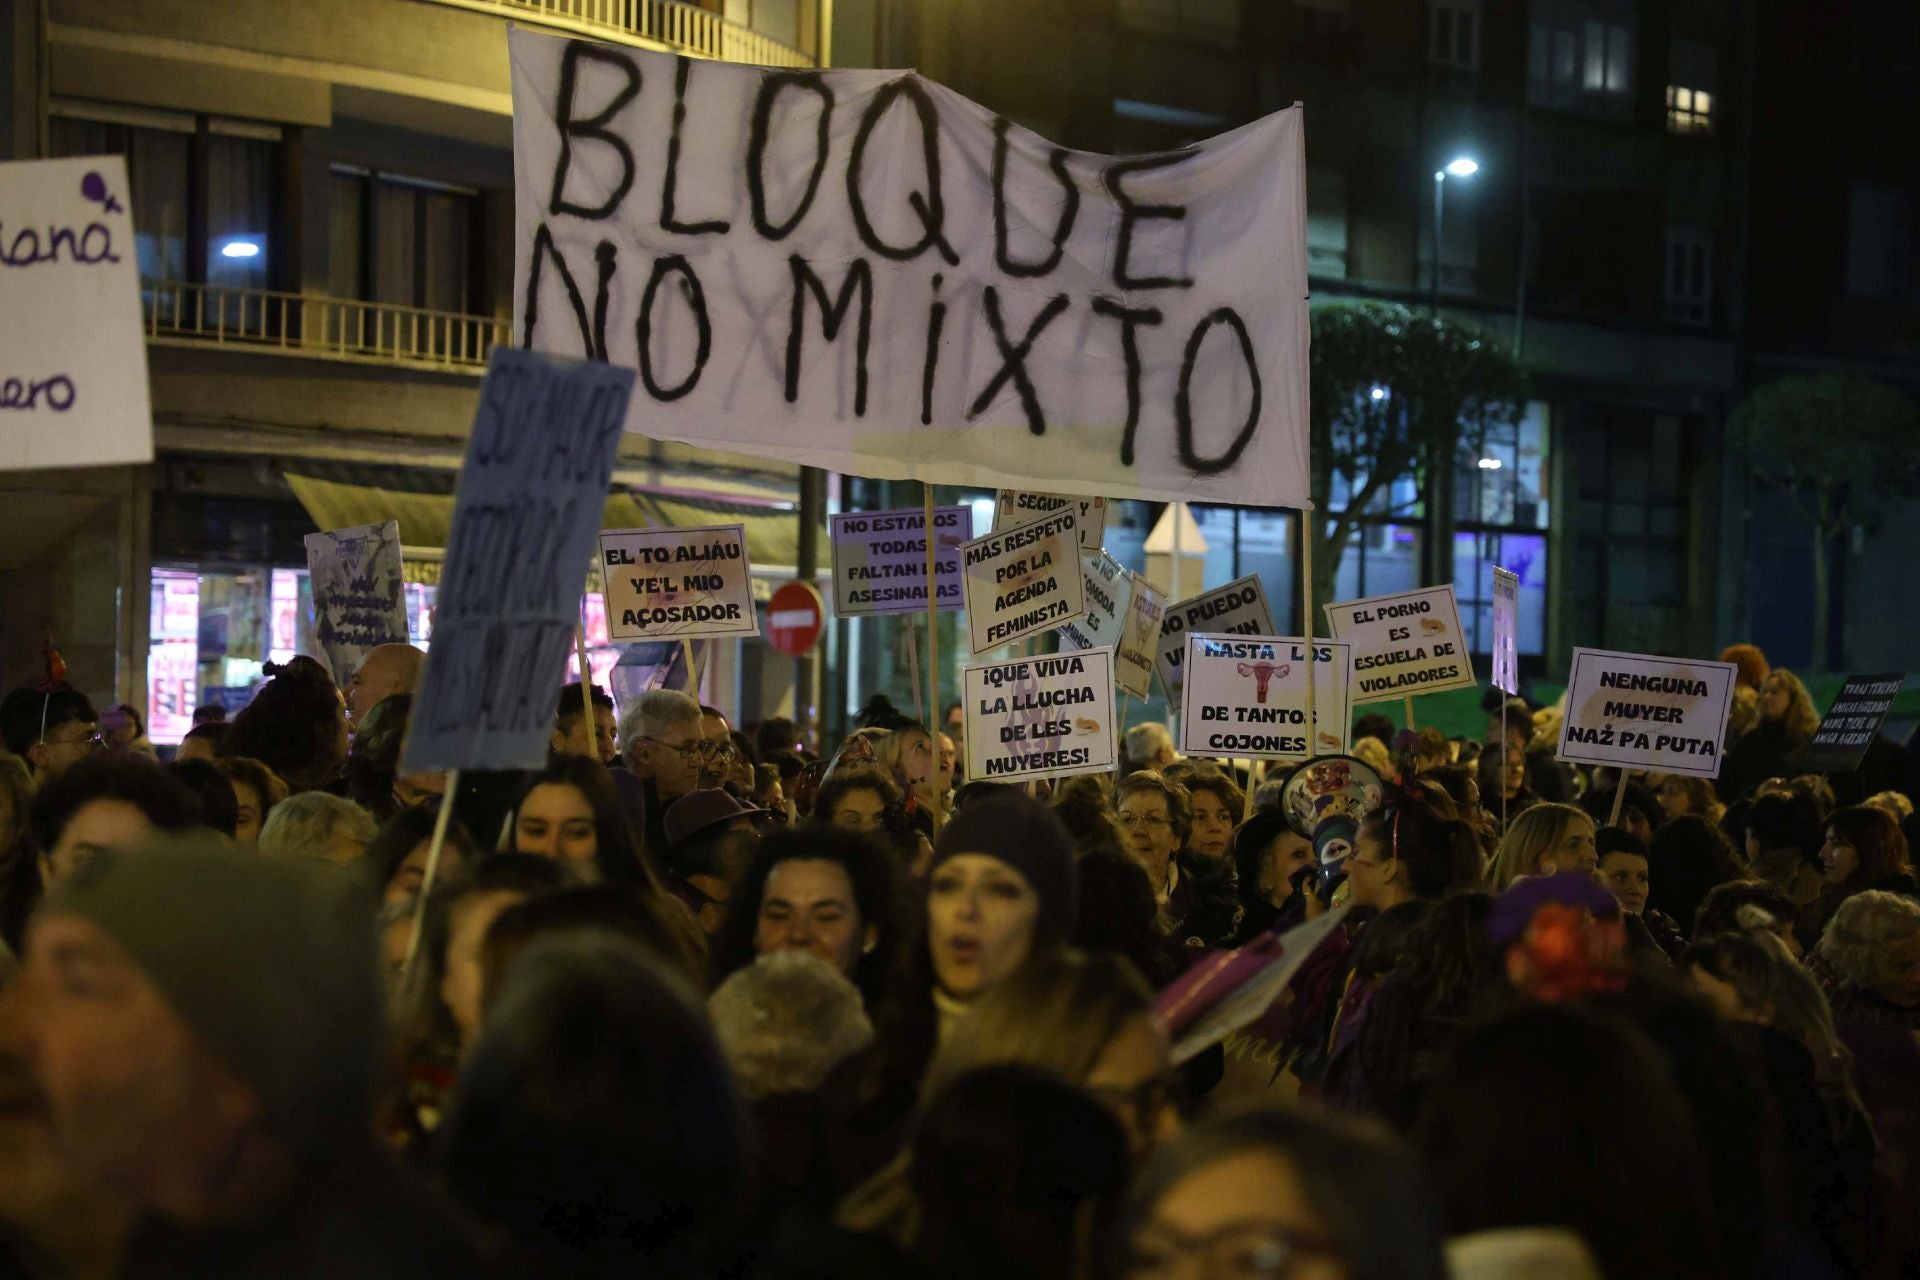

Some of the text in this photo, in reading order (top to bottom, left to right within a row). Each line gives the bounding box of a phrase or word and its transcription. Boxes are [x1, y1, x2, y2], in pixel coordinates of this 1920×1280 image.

[550, 40, 1205, 290] BLOQUE
[0, 222, 120, 266] ana
[524, 224, 711, 402] NO
[1017, 493, 1089, 516] SEGUR Y
[843, 520, 868, 533] NO
[605, 540, 740, 565] EL TO ALIÁU
[869, 539, 927, 555] TODAS
[966, 540, 1002, 566] MÁS
[1004, 515, 1074, 552] RESPETO
[848, 563, 918, 580] FALTAN
[995, 551, 1052, 584] POR LA
[630, 574, 724, 594] YE'L MIO
[995, 576, 1057, 612] AGENDA
[1083, 574, 1115, 619] OMODA,
[987, 600, 1069, 643] FEMINISTA
[1087, 612, 1100, 631] ES
[1159, 587, 1257, 638] NO PUEDO
[1353, 600, 1431, 624] EL PORNO
[1388, 627, 1410, 641] ES
[1204, 643, 1275, 661] HASTA
[1354, 643, 1456, 671] ESCUELA DE
[983, 657, 1085, 688] ¡QUE VIVA
[1359, 665, 1459, 693] VIOLADORES
[1600, 671, 1708, 697] NENGUNA
[980, 686, 1096, 715] LA LLUCHA
[1603, 701, 1684, 724] MUYER
[1201, 706, 1229, 721] DE
[1000, 720, 1072, 743] DE LES
[1209, 733, 1307, 751] COJONES
[1619, 732, 1650, 750] PA
[1655, 735, 1716, 756] PUTA
[985, 747, 1090, 775] MUYERES!
